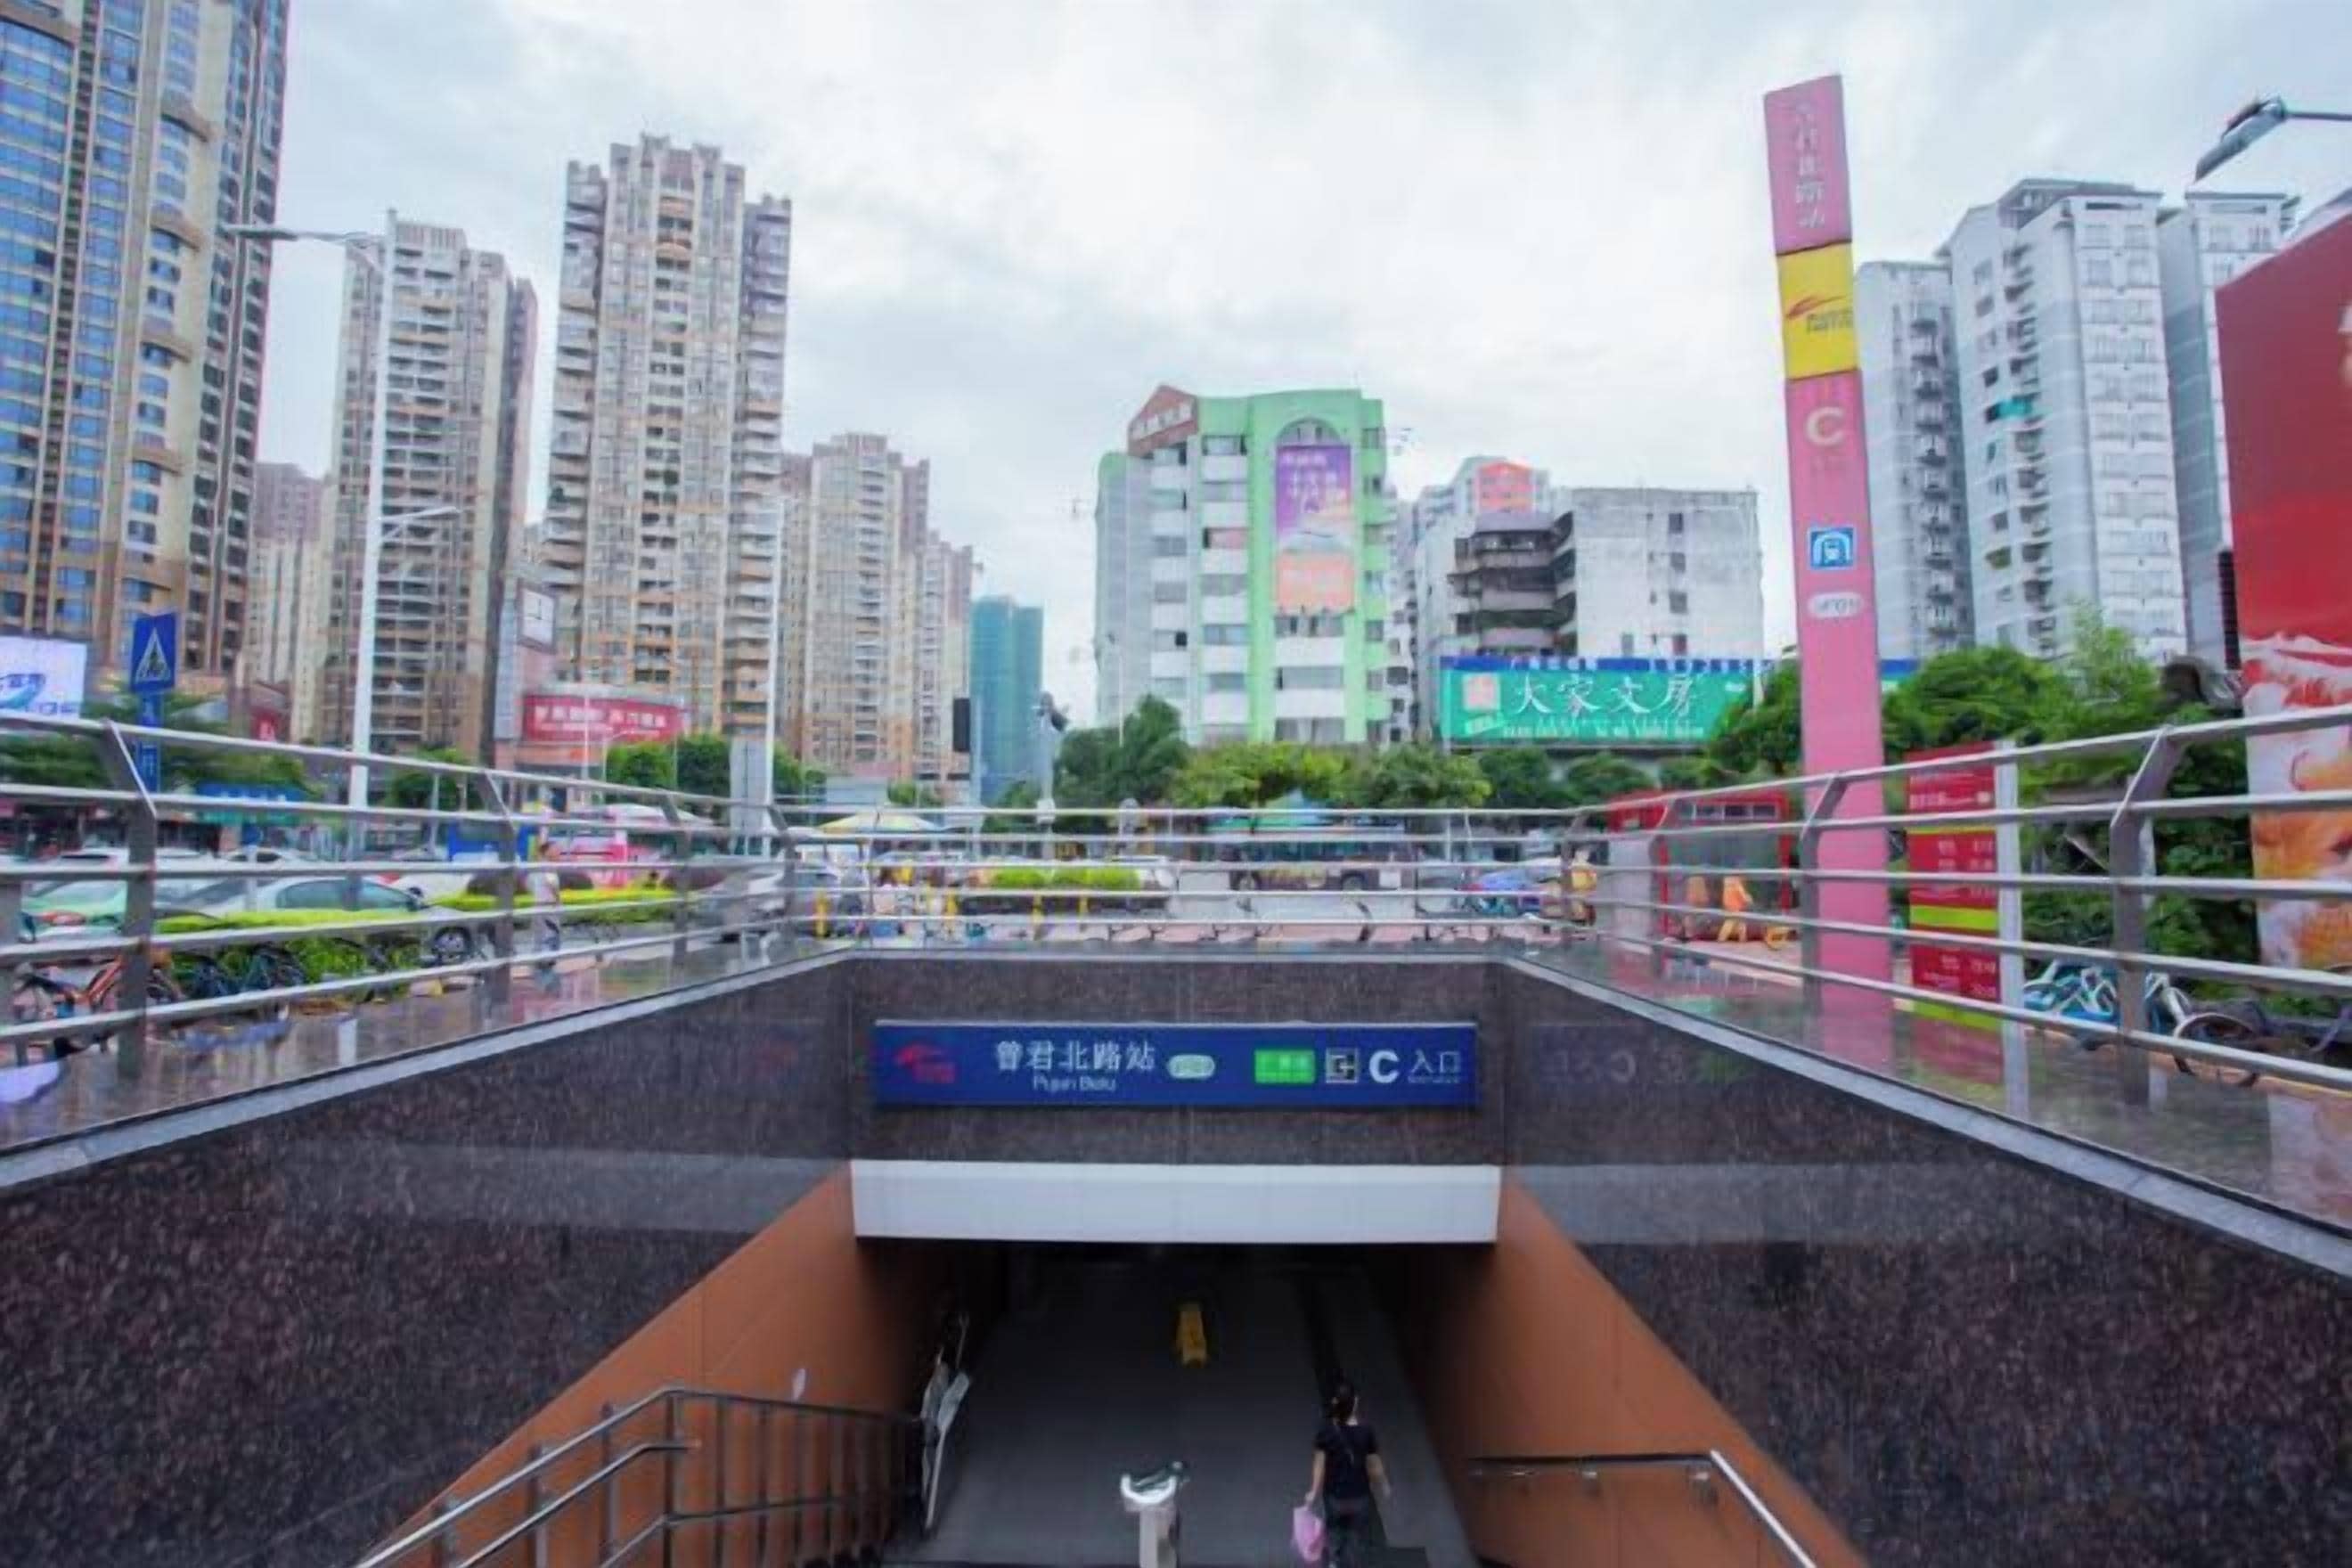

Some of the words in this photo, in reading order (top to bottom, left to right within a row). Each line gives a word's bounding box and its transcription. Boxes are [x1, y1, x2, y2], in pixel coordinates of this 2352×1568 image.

[1806, 406, 1845, 445] C
[1368, 1049, 1400, 1083] C
[1409, 1049, 1461, 1074] 入口
